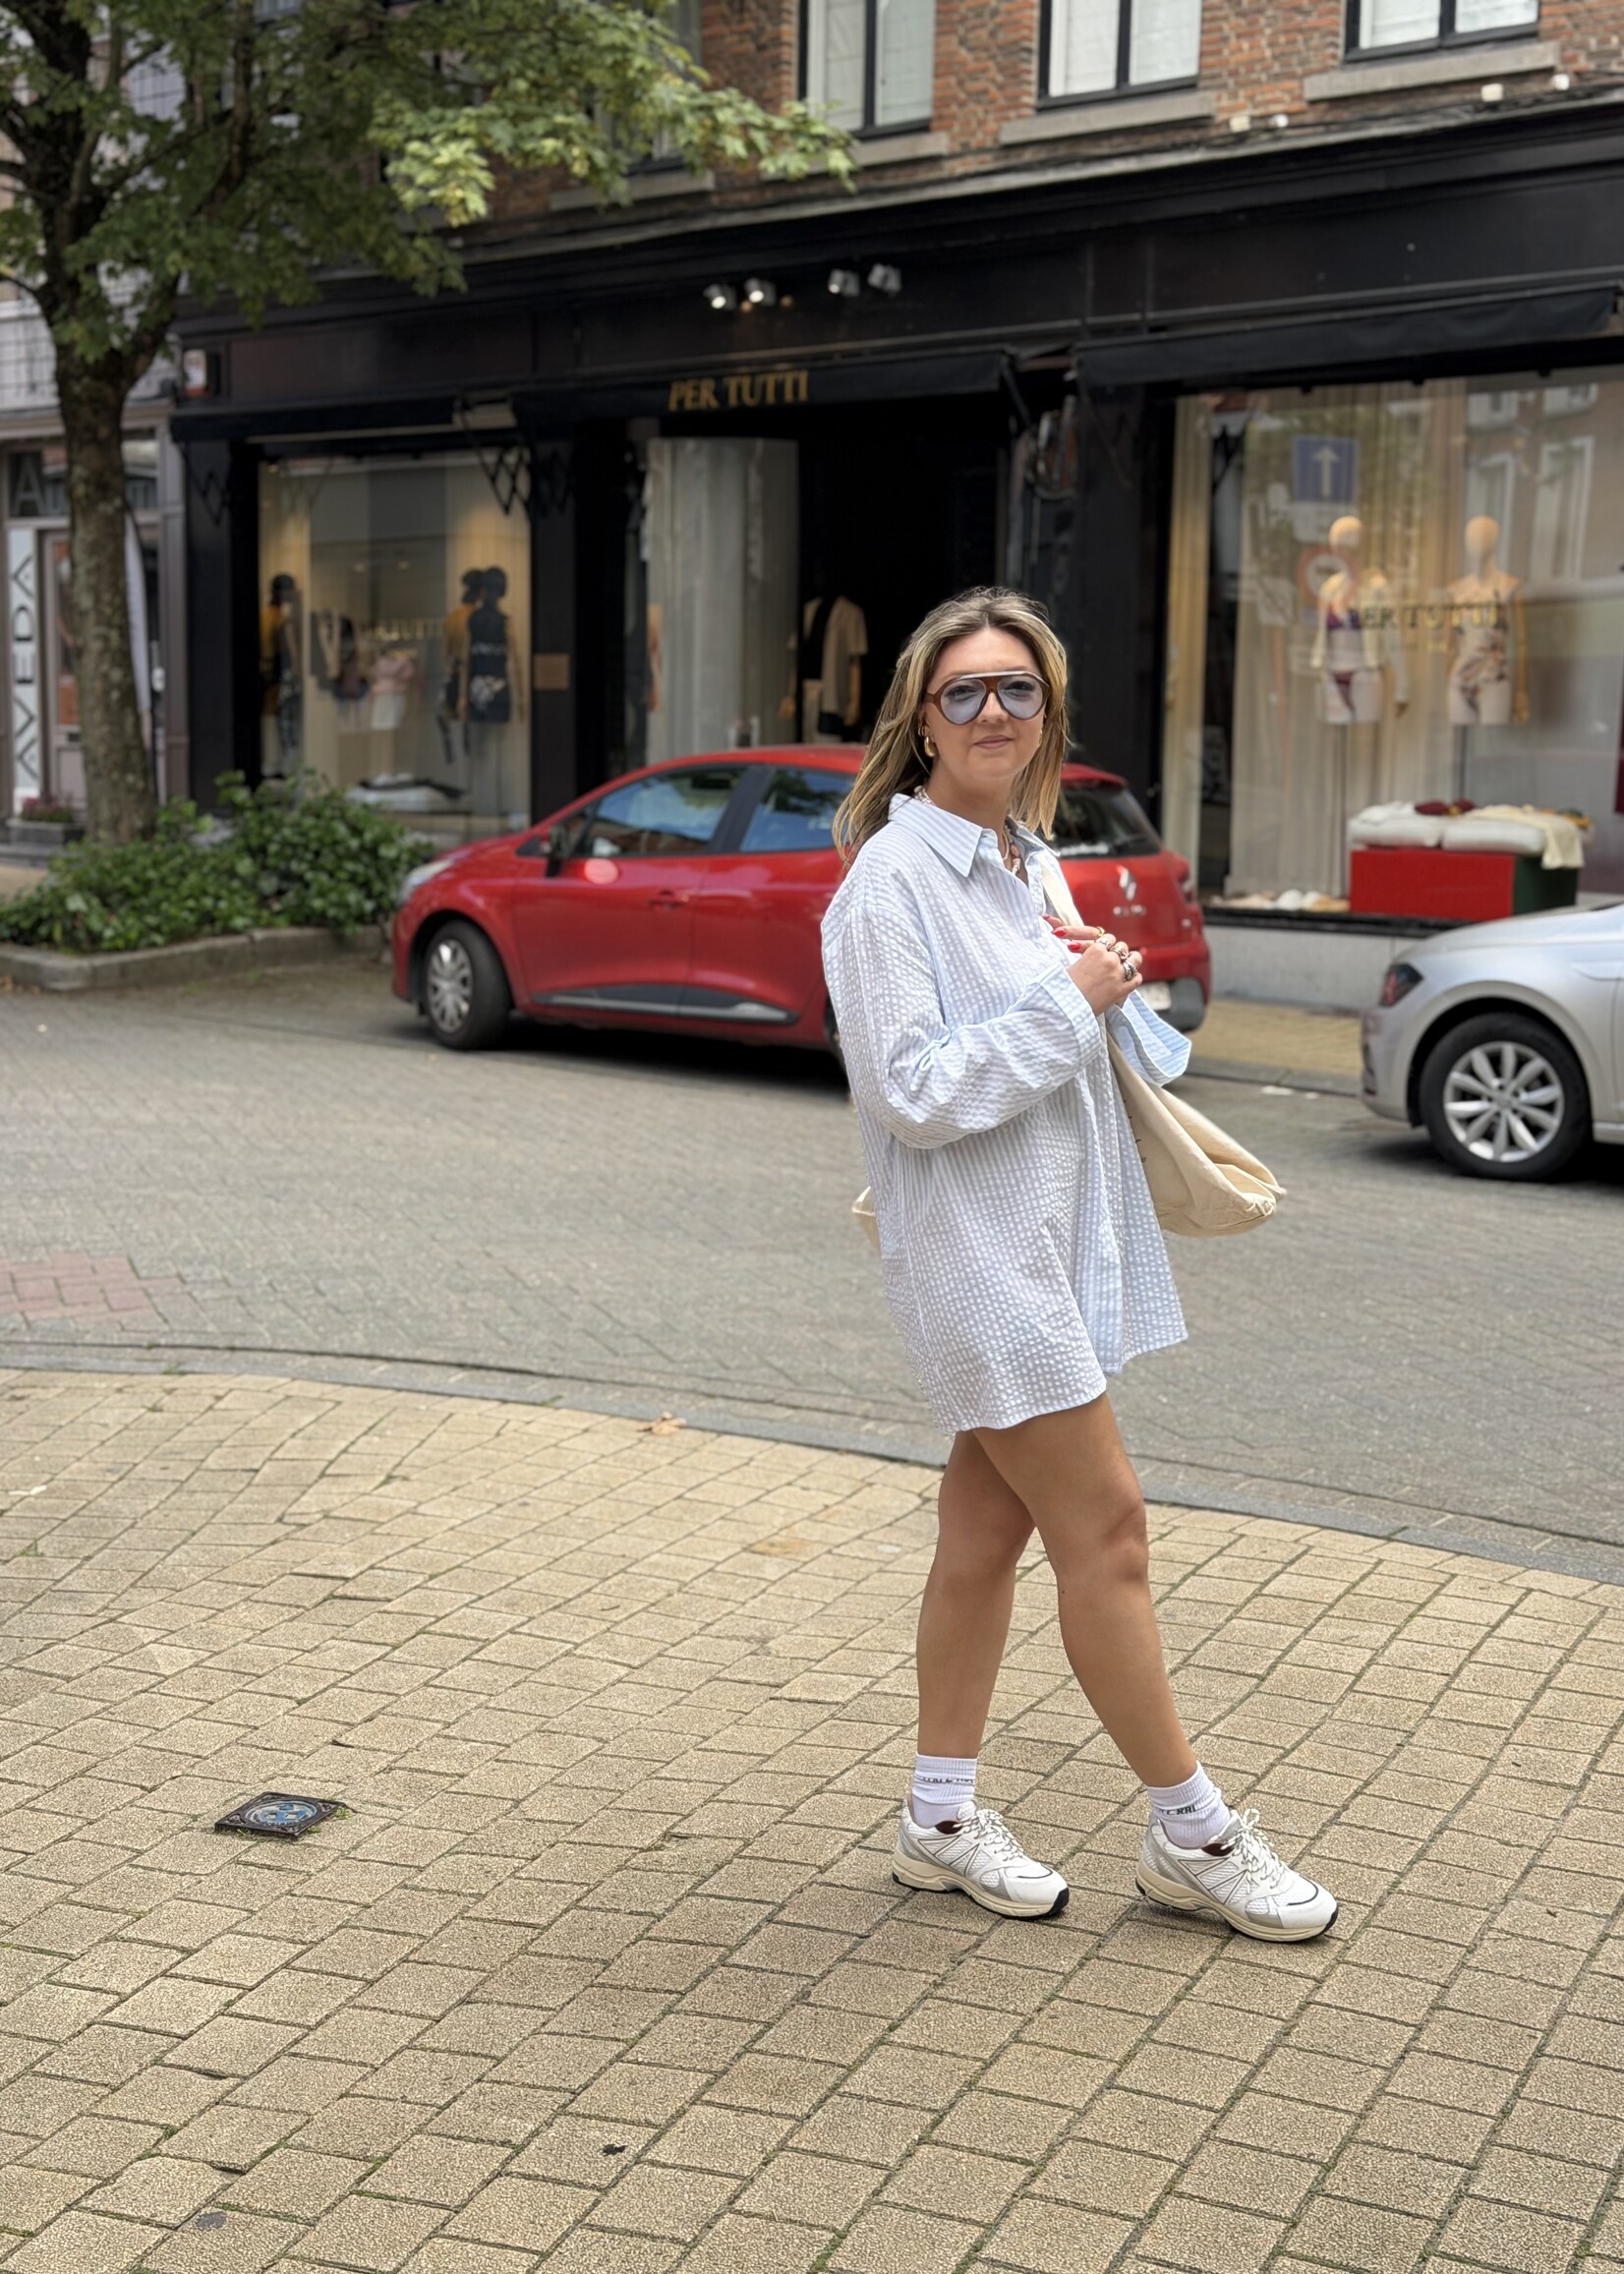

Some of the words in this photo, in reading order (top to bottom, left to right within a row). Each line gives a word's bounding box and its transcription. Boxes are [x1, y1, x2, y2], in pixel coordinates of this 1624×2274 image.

[669, 378, 719, 410] PER
[725, 371, 808, 406] TUTTI
[11, 555, 37, 780] AVEDA
